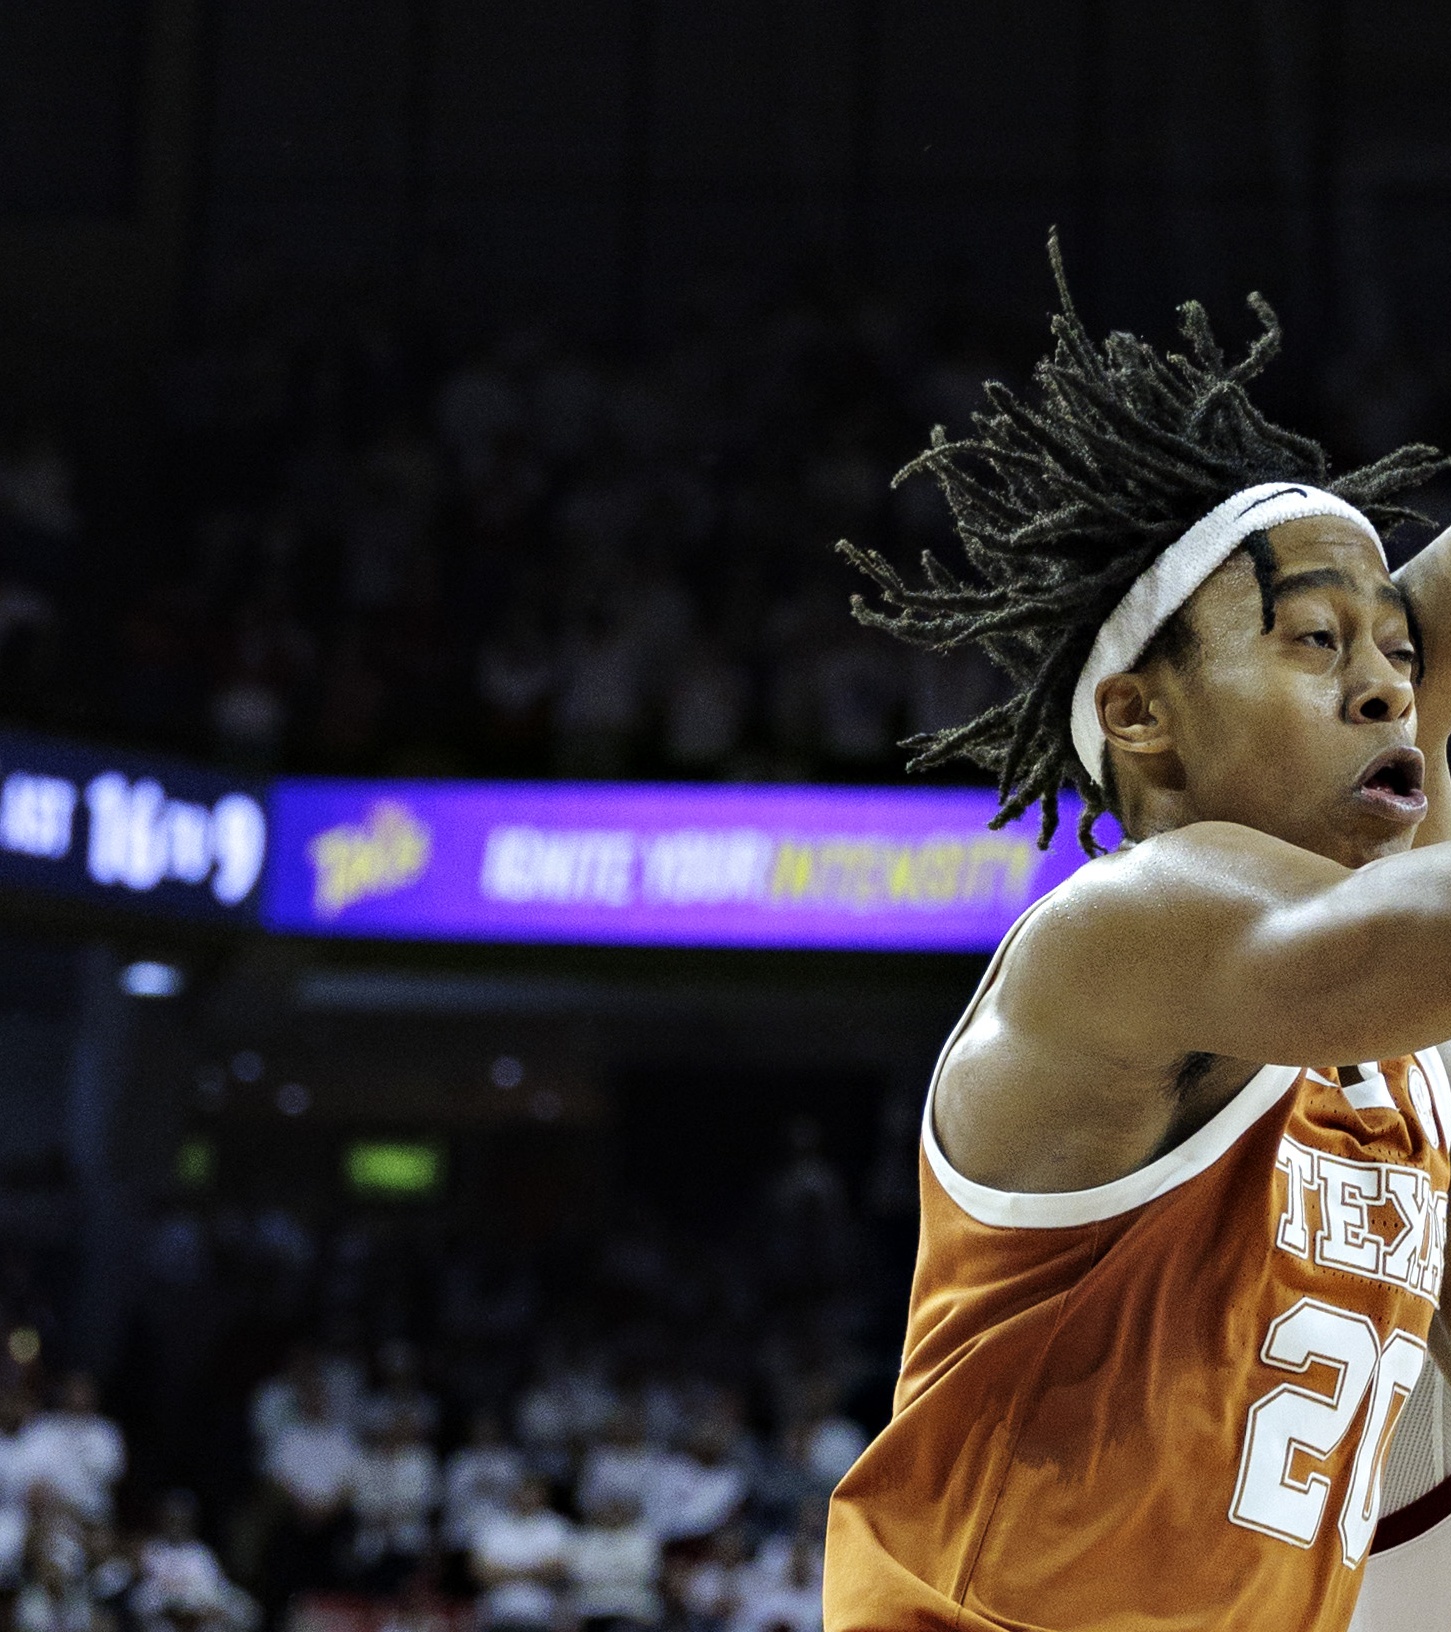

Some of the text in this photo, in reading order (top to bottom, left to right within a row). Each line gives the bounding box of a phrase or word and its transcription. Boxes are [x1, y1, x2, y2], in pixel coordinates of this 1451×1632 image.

[481, 826, 634, 906] IGNITE
[638, 826, 769, 904] YOUR
[771, 834, 1042, 914] INTENSITY
[1228, 1297, 1428, 1570] 20
